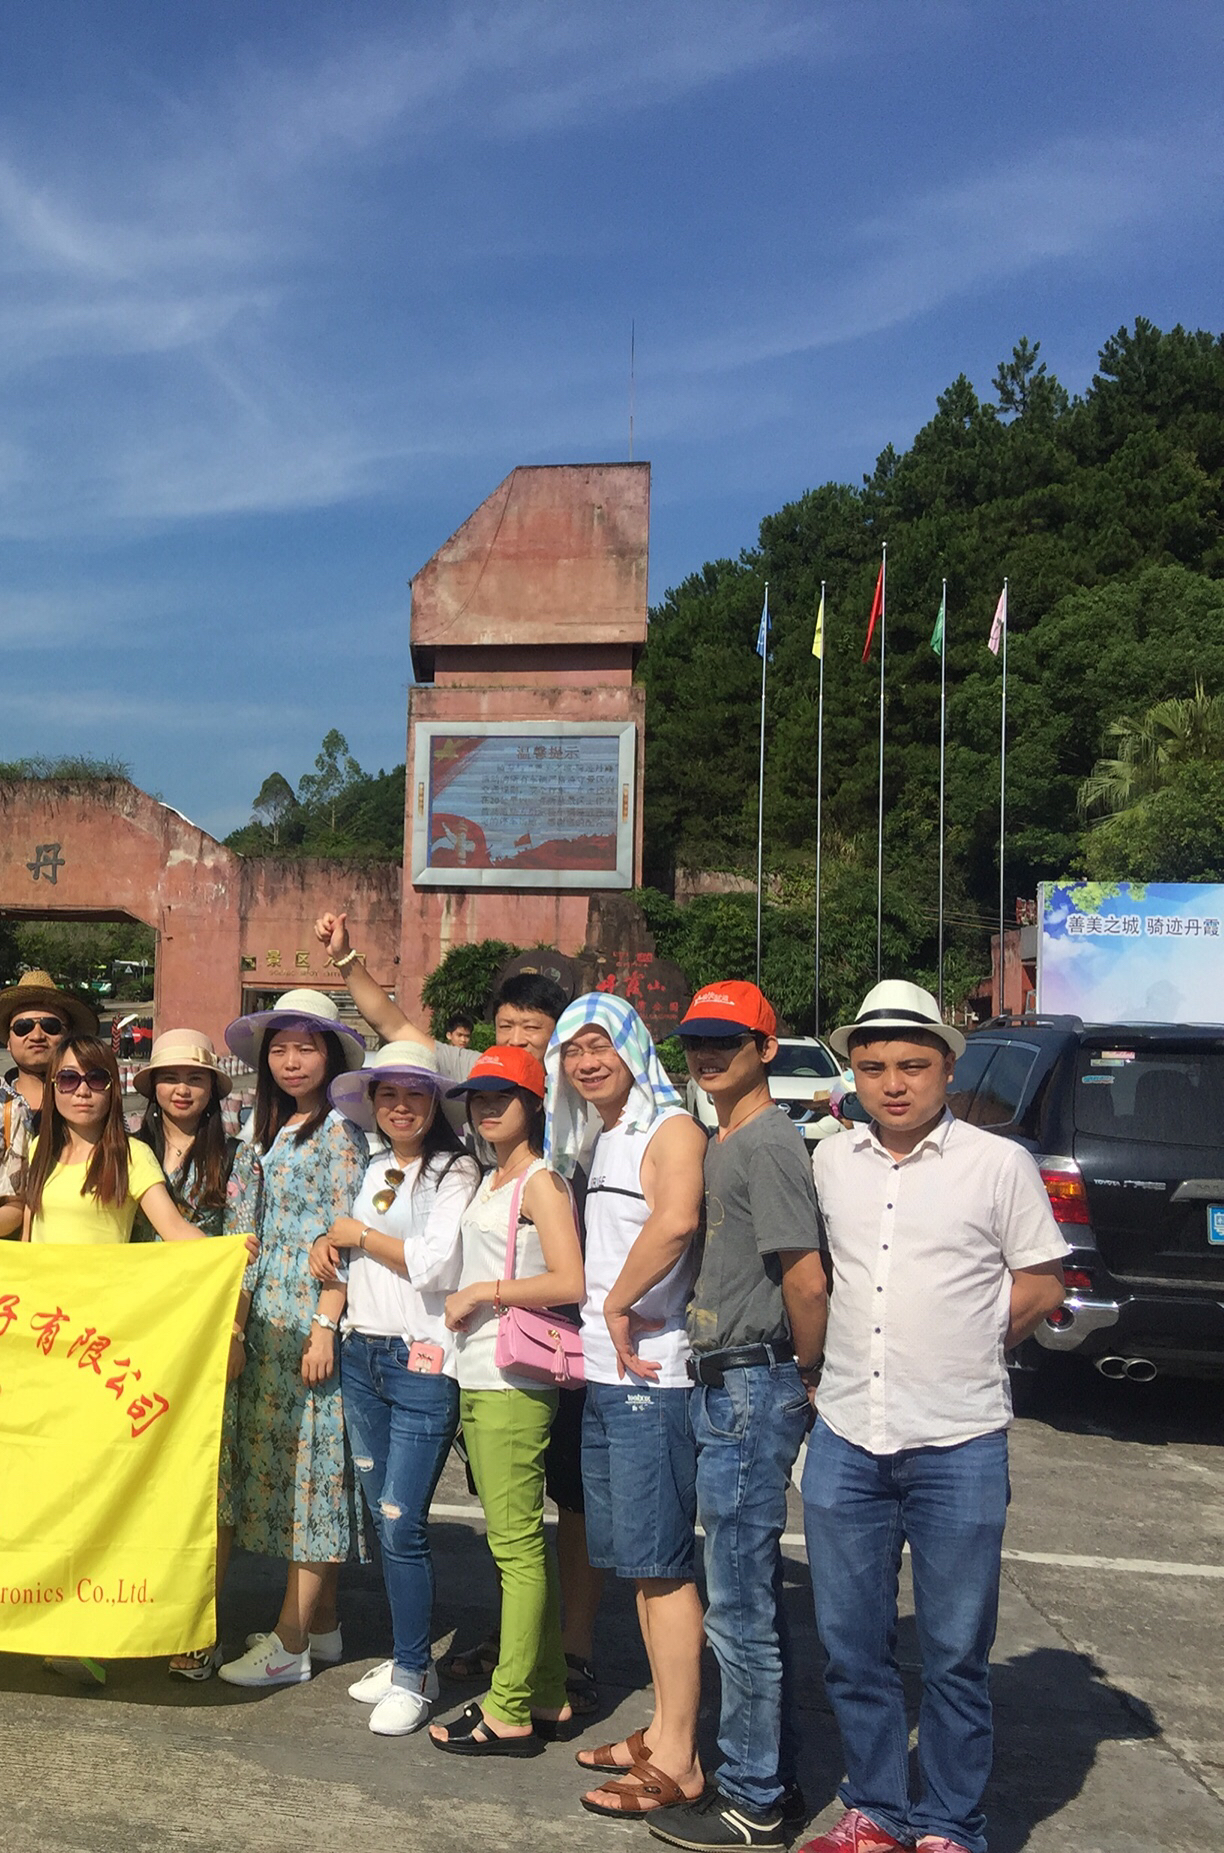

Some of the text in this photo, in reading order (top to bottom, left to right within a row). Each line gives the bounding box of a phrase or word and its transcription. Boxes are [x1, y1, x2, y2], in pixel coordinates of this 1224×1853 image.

[1068, 915, 1220, 937] 善美之城 骑迹丹霞
[1093, 1178, 1121, 1187] TOYOTA
